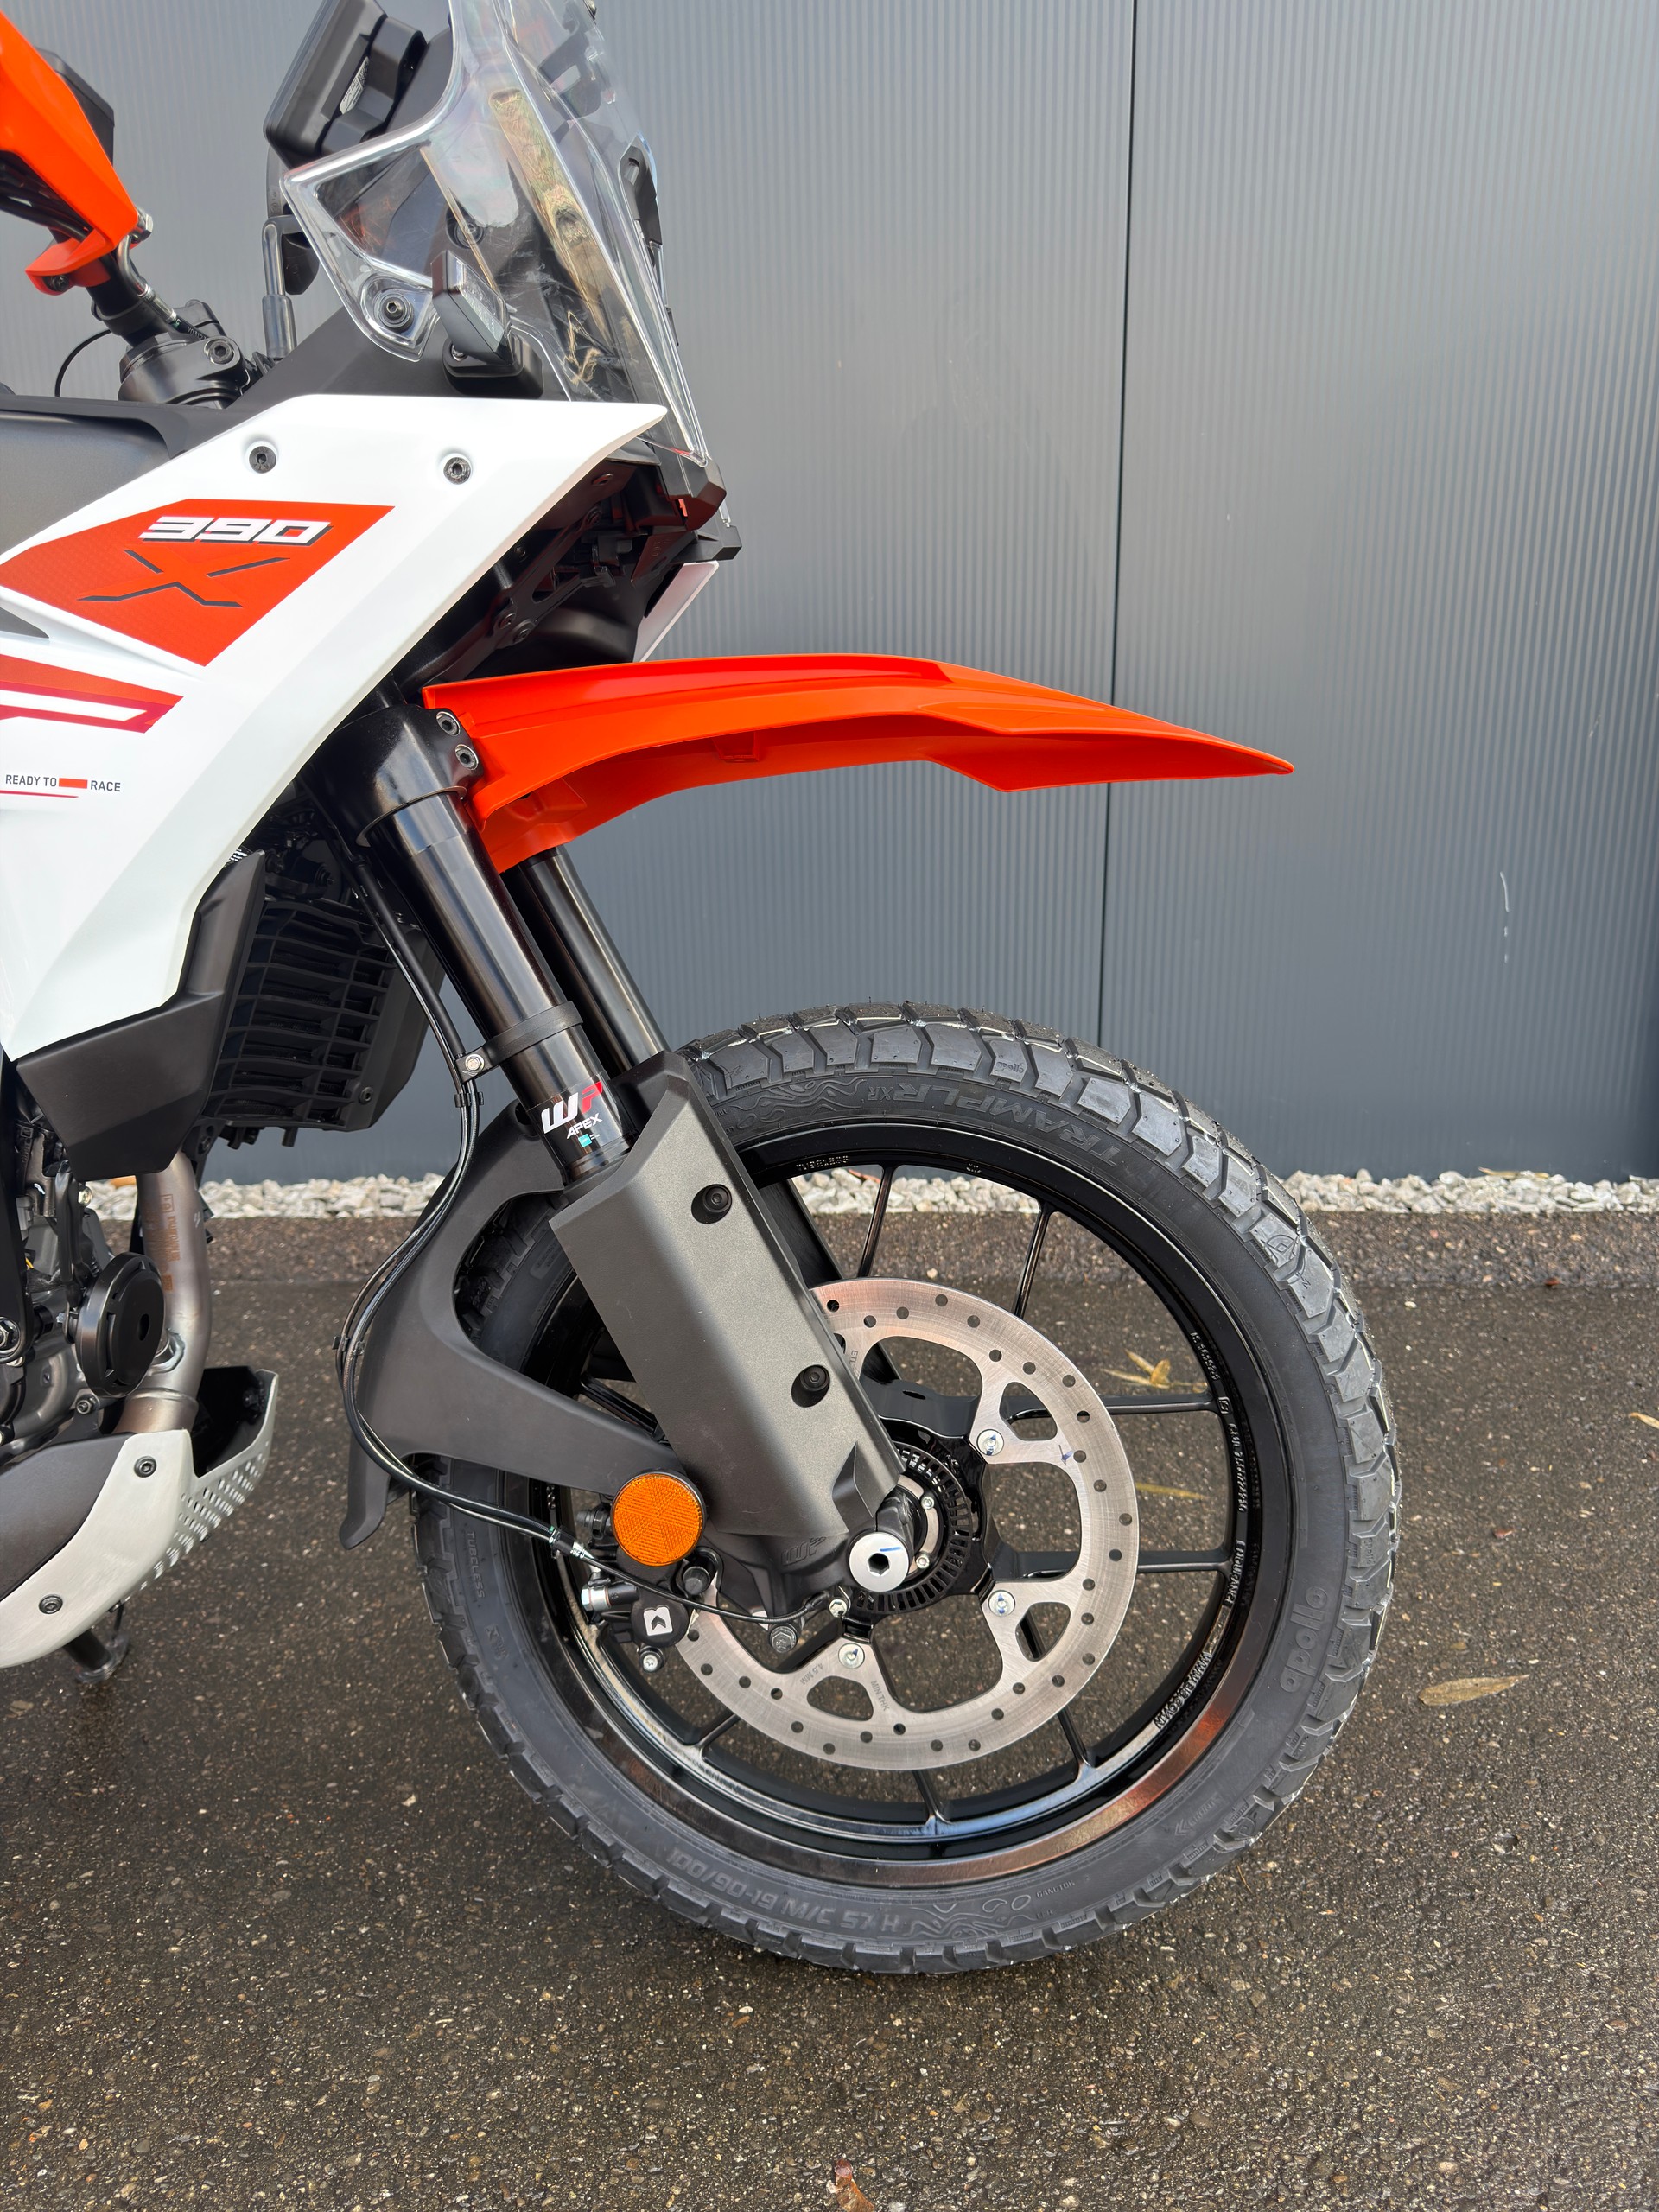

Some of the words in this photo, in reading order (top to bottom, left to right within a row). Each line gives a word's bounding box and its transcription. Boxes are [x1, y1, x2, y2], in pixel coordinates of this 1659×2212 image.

[138, 516, 334, 546] 390
[5, 774, 41, 786] READY
[43, 776, 57, 787] TO
[90, 780, 121, 792] RACE
[541, 1081, 603, 1134] WP
[867, 1084, 892, 1102] XR
[566, 1113, 603, 1139] APEX
[893, 1084, 1122, 1163] TRAMPLR
[467, 1530, 486, 1599] TUBELESS
[1281, 1586, 1328, 1694] apollo
[800, 1671, 814, 1685] MM
[871, 1680, 881, 1695] MIN
[879, 1694, 890, 1711] THK
[781, 1898, 836, 1925] M/C
[840, 1910, 875, 1931] 57
[880, 1913, 900, 1933] H
